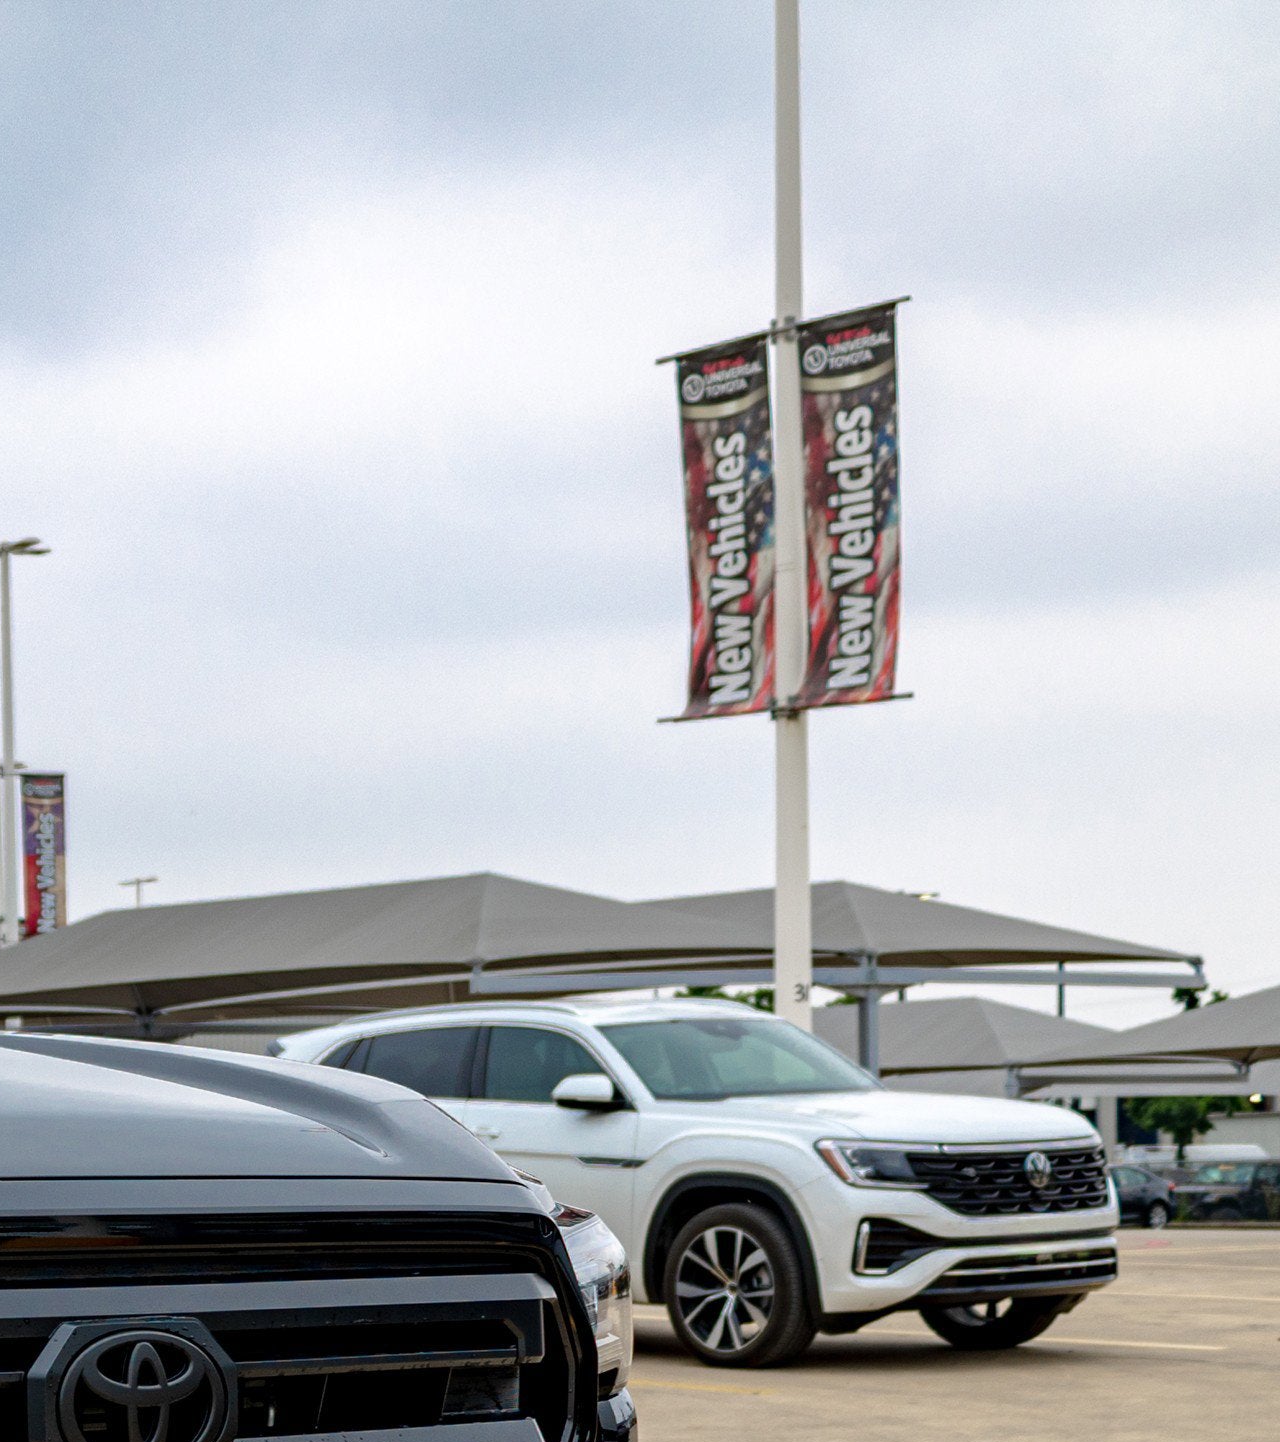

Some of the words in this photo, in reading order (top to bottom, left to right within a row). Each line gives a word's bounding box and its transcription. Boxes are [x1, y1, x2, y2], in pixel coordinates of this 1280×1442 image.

[704, 360, 763, 384] UNIVERSAL
[827, 331, 891, 355] UNIVERSAL
[828, 348, 875, 370] TOYOTA
[705, 377, 749, 399] TOYOTA
[706, 431, 749, 608] Vehicles
[827, 404, 874, 590] Vehicles
[708, 614, 752, 705] New
[827, 596, 874, 689] New
[36, 813, 55, 889] Vehicles
[37, 892, 56, 933] New
